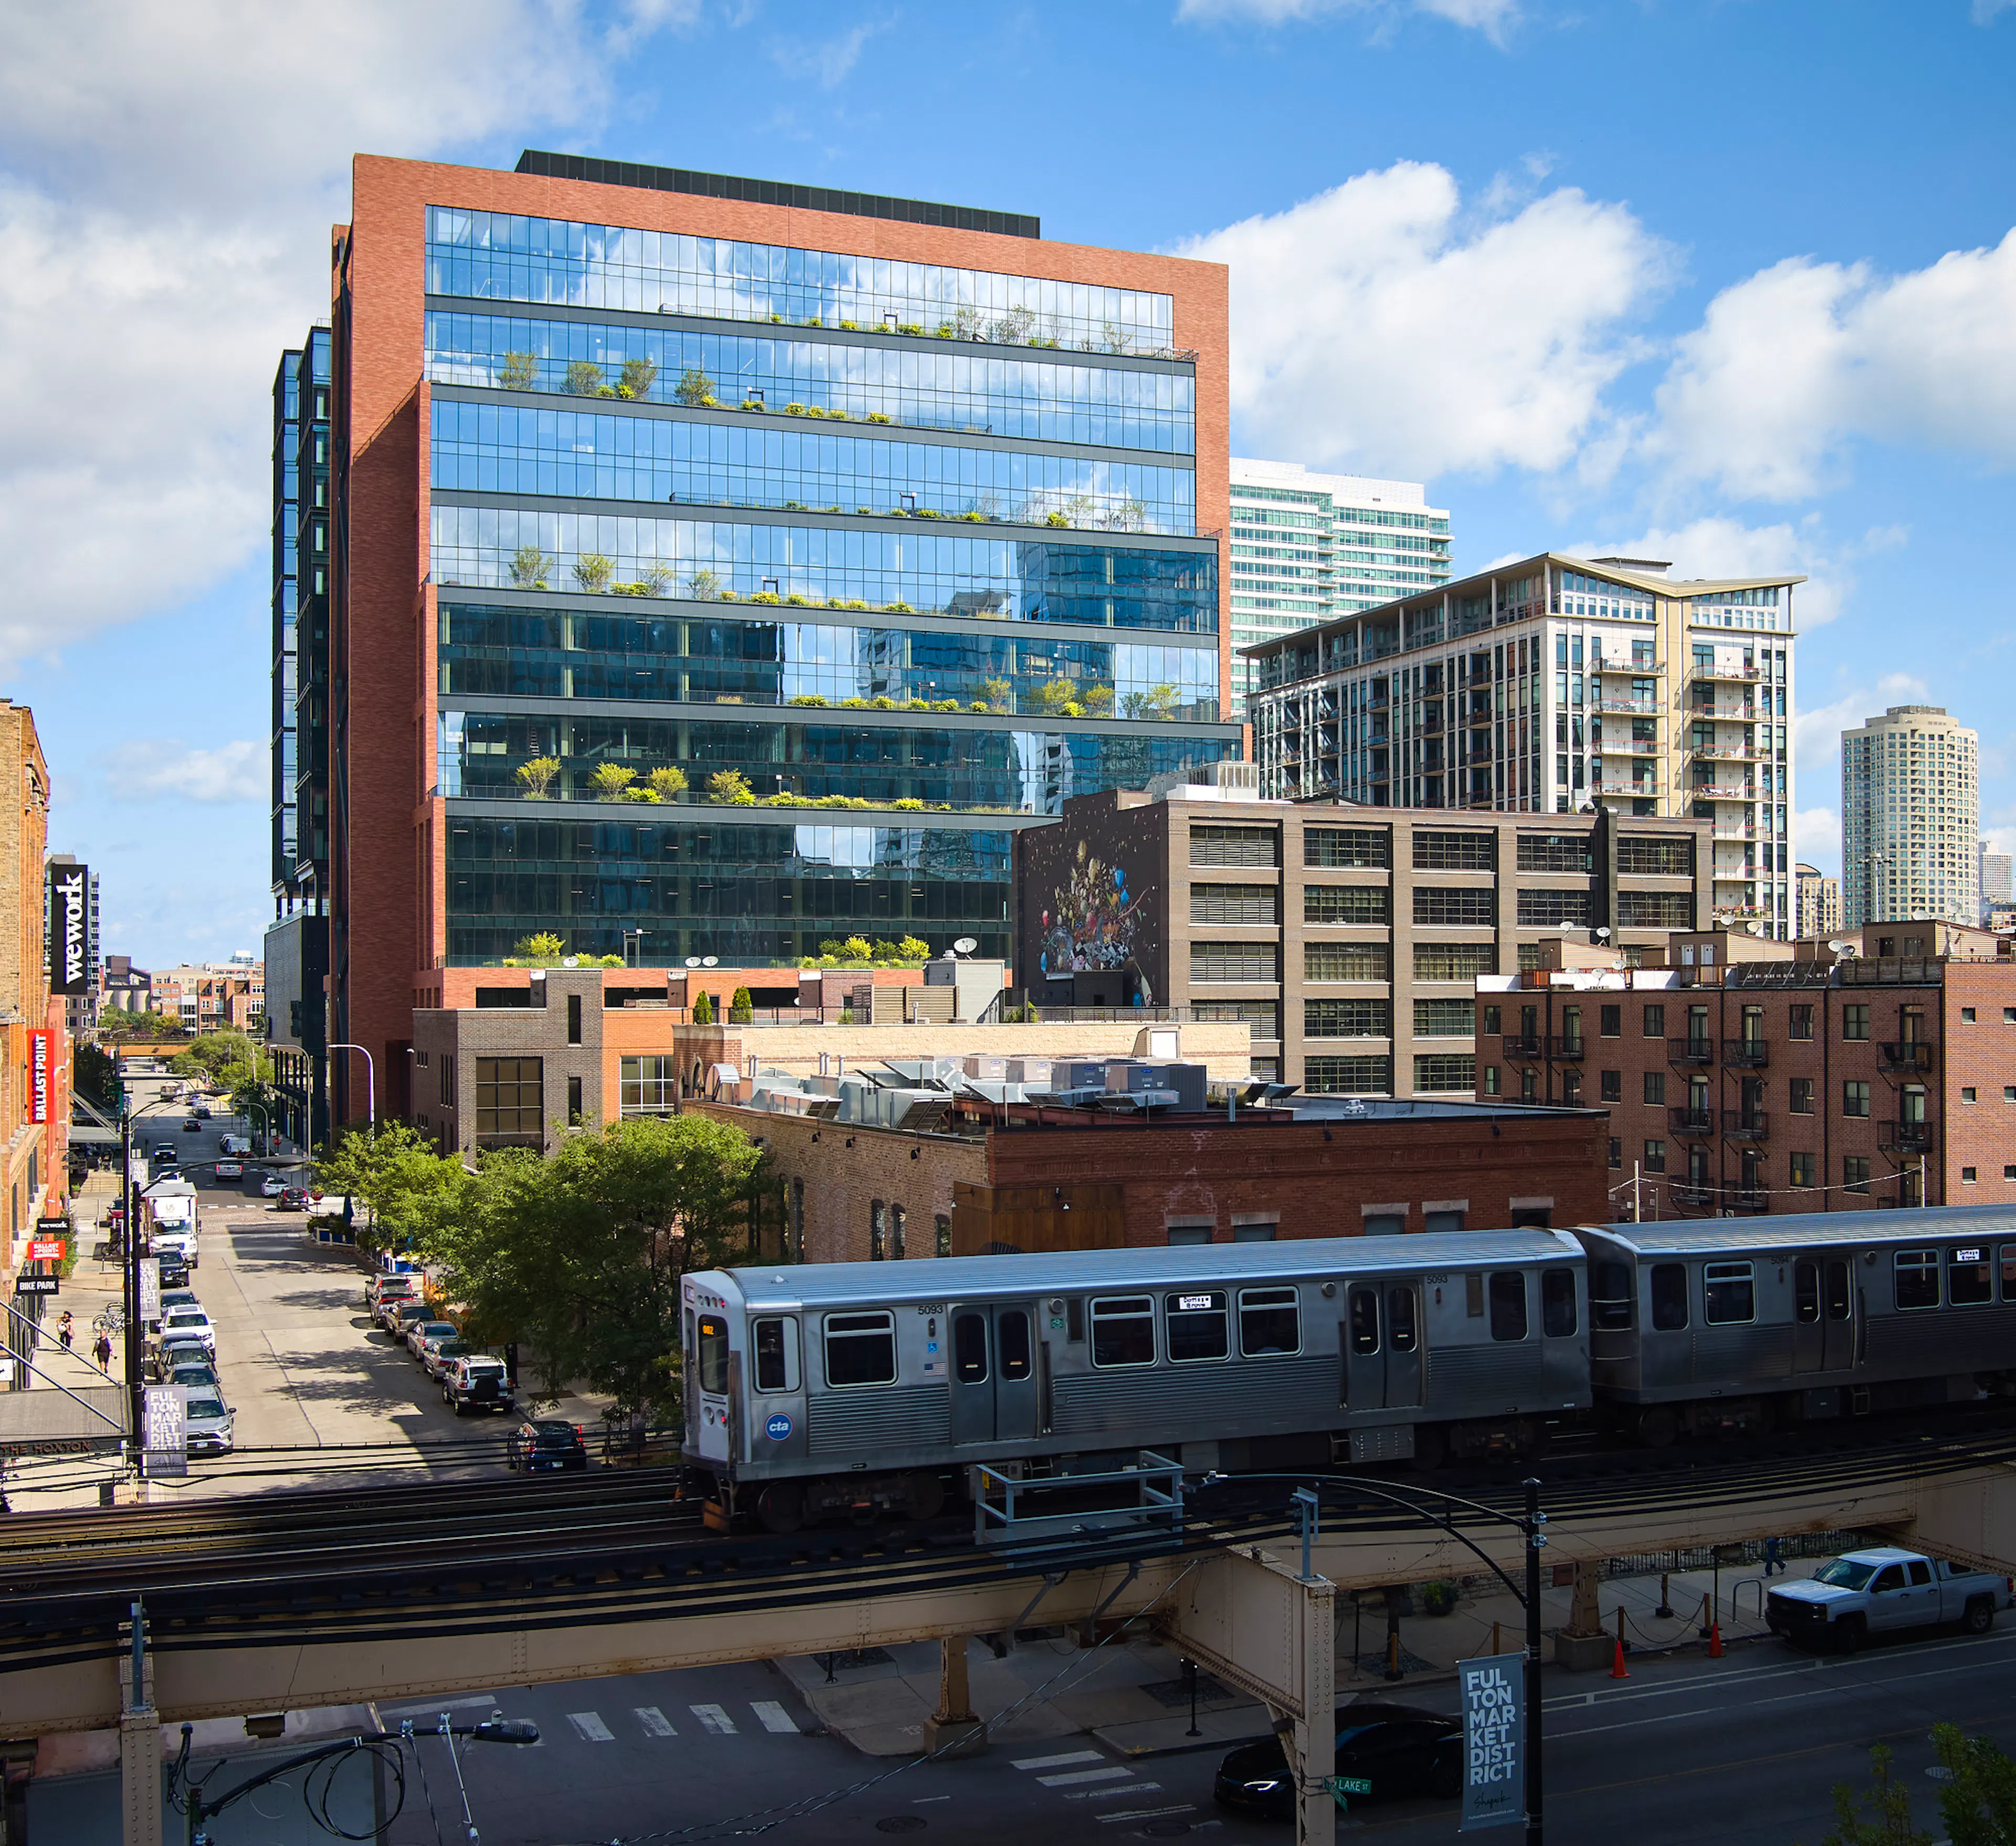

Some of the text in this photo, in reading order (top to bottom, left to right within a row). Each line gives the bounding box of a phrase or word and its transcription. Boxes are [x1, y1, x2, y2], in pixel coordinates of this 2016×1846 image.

[56, 872, 83, 984] wework
[35, 1033, 47, 1121] BALLAST POINT
[1427, 1274, 1448, 1284] 5093
[19, 1281, 56, 1290] BIKE PARK
[918, 1305, 943, 1315] 5093
[151, 1392, 177, 1402] FUL
[151, 1401, 180, 1412] TON
[151, 1412, 182, 1422] MAR
[151, 1422, 178, 1433] KET
[769, 1421, 789, 1432] cta
[151, 1432, 182, 1443] DIST
[1, 1440, 90, 1454] THE HOXTON
[1467, 1668, 1507, 1691] FUL
[1468, 1685, 1511, 1710] TON
[1469, 1704, 1516, 1729] MAR
[1470, 1724, 1510, 1748] KET
[1470, 1742, 1516, 1767] DIST
[1470, 1760, 1516, 1786] RICT
[1338, 1779, 1361, 1791] LAKE
